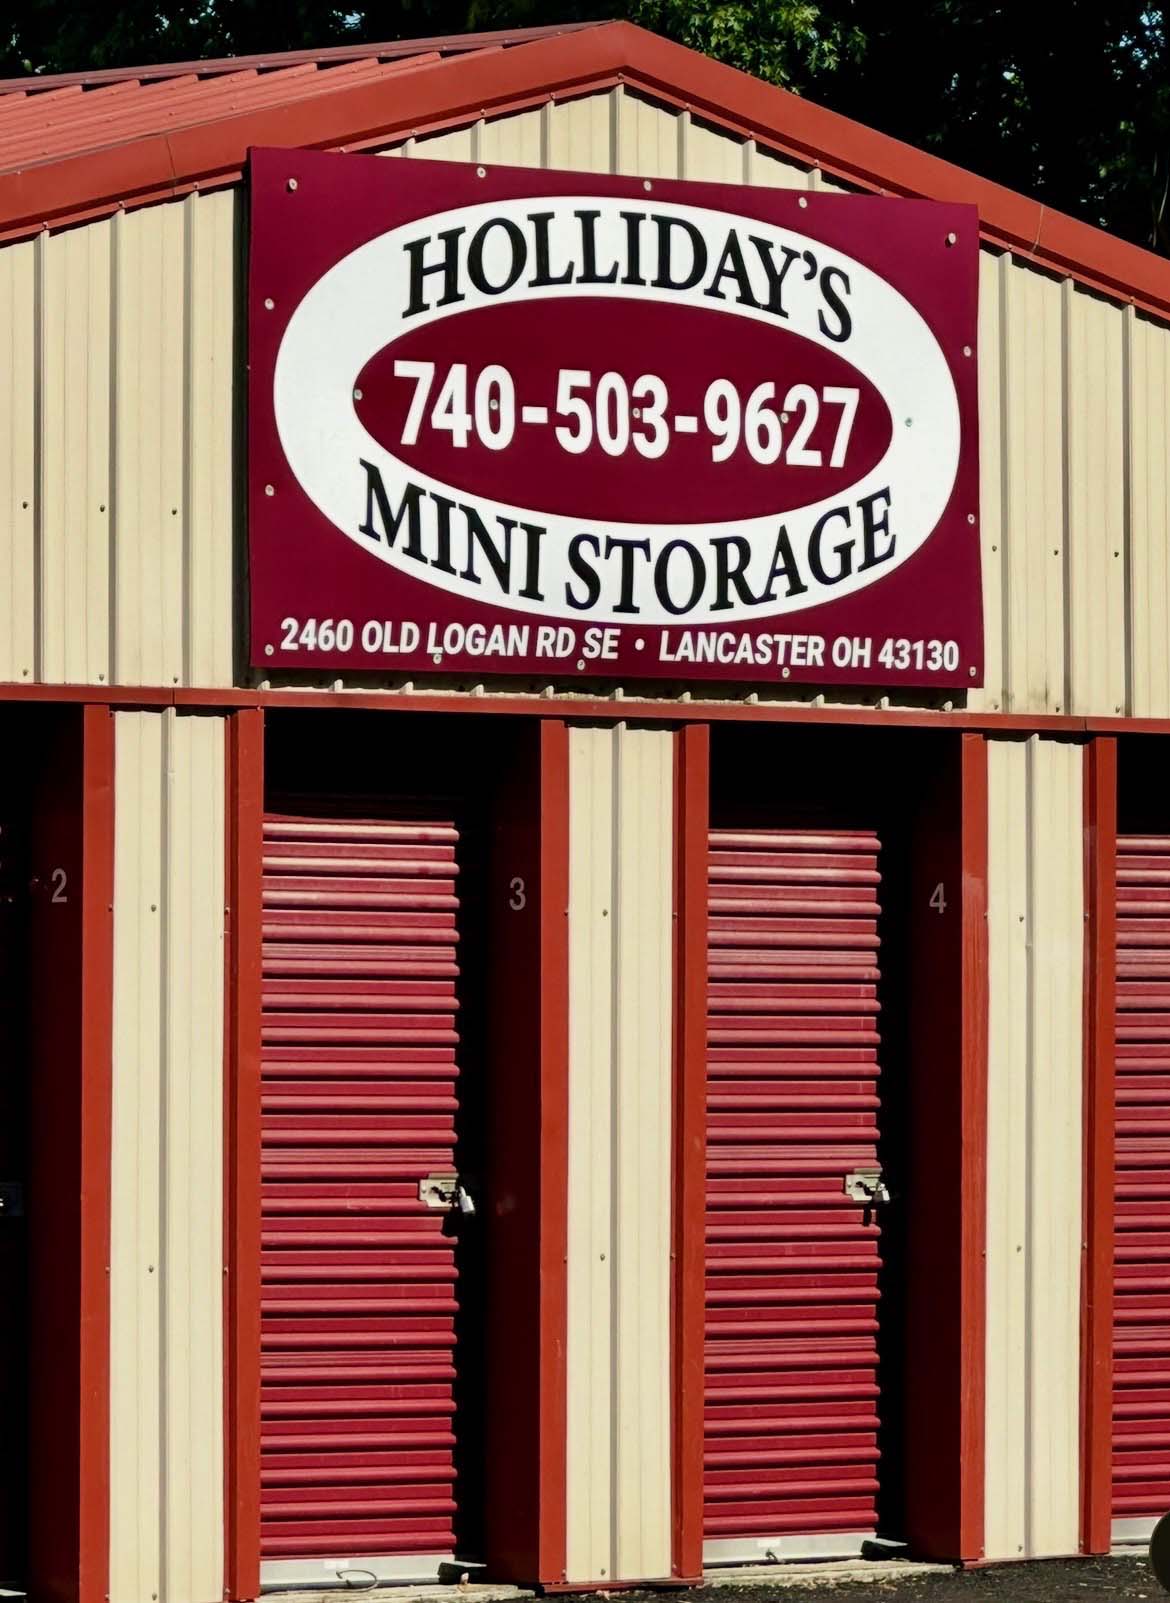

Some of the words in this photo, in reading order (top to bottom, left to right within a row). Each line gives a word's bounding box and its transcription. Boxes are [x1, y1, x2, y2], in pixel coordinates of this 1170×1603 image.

[401, 210, 852, 343] HOLLIDAY'S
[393, 360, 860, 468] 740-503-9627
[359, 458, 547, 601] MINI
[565, 486, 897, 615] STORAGE
[280, 617, 353, 651] 2460
[361, 620, 420, 653] OLD
[427, 622, 530, 656] LOGAN
[535, 626, 576, 658] RD
[582, 628, 621, 659] SE
[658, 630, 825, 667] LANCASTER
[832, 636, 872, 668] OH
[878, 639, 960, 671] 43130
[51, 869, 68, 903] 2
[509, 877, 526, 910] 3
[929, 883, 947, 914] 4
